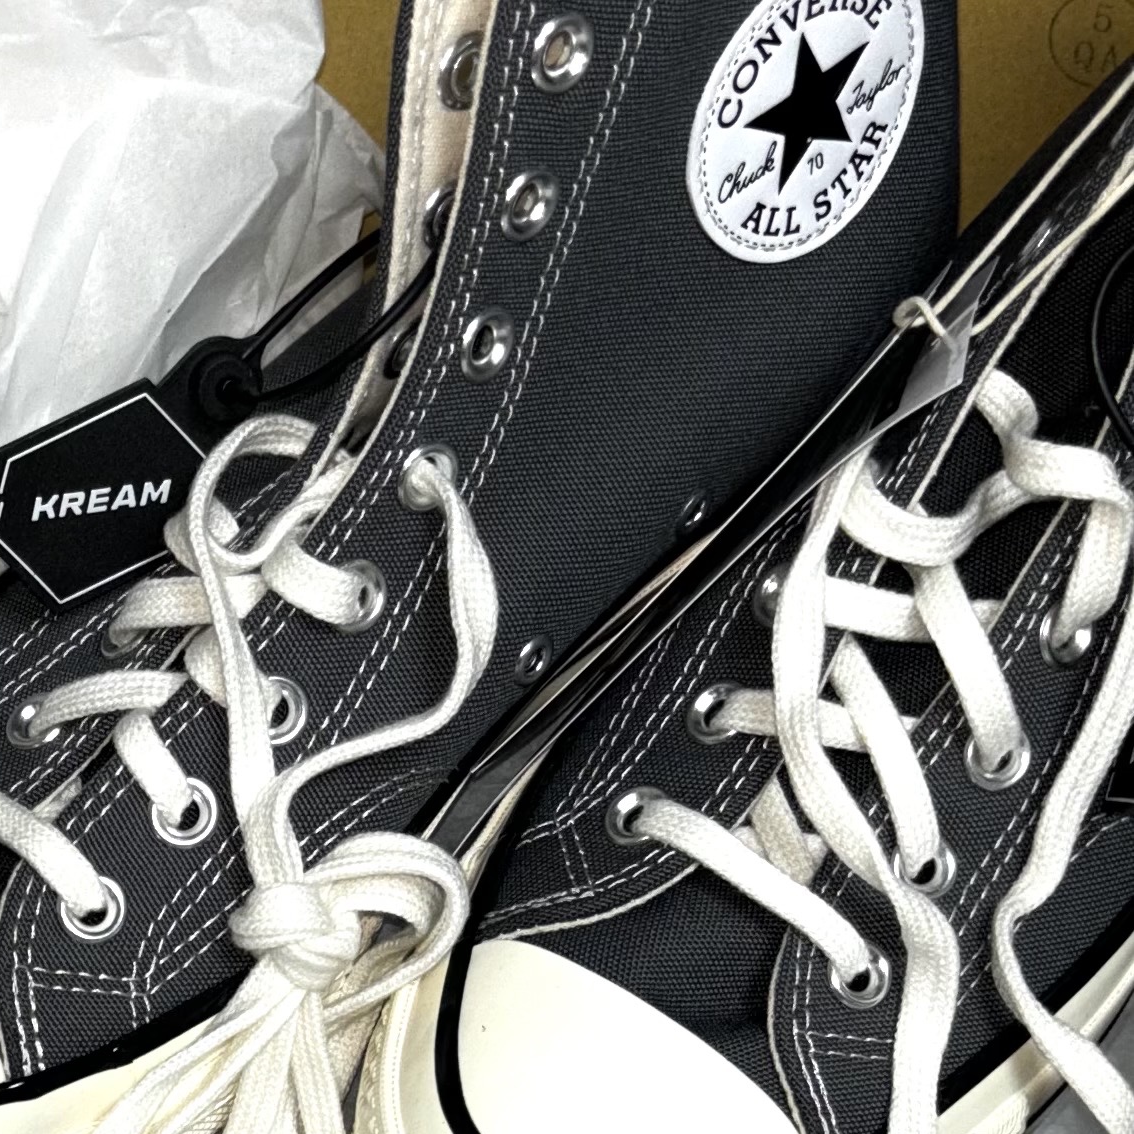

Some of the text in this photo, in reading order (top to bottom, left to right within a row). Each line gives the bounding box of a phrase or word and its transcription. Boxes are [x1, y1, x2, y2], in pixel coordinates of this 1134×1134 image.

[846, 58, 906, 115] Taylor
[718, 141, 778, 204] Chuck
[741, 121, 889, 237] ALL STAR
[807, 152, 825, 176] 70
[31, 478, 172, 522] KREAM
